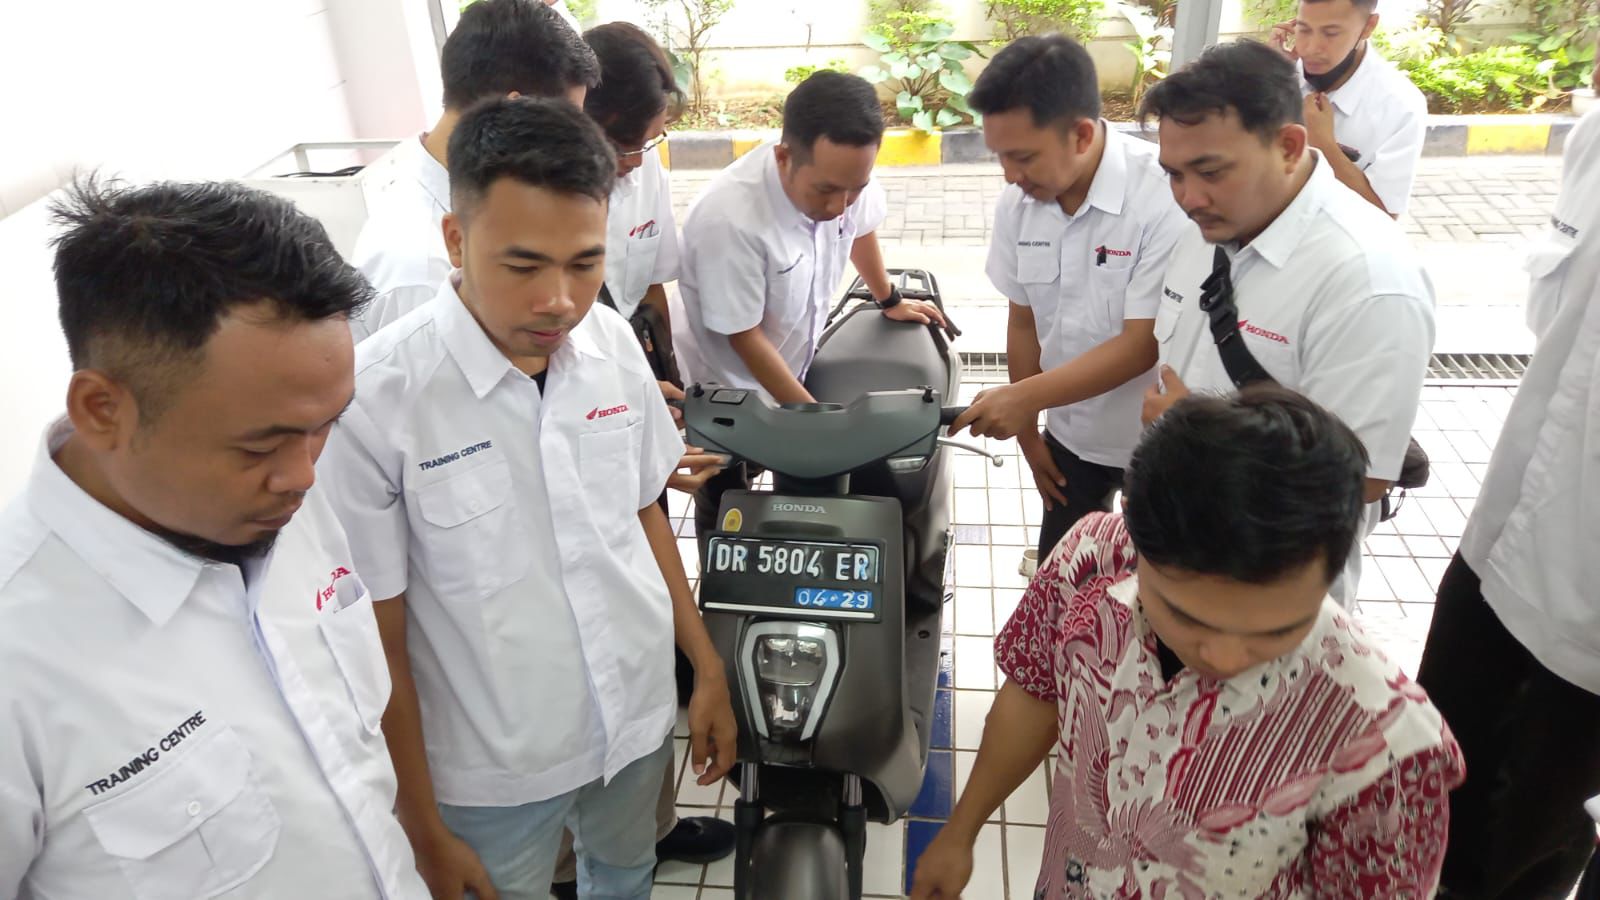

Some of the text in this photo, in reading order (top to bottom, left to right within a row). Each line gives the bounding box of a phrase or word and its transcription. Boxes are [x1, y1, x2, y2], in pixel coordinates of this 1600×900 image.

[1246, 324, 1289, 344] HONDA
[418, 440, 493, 471] TRAINING CENTRE
[773, 503, 827, 514] HONDA
[716, 543, 868, 580] DR 5804 ER
[85, 710, 207, 797] TRAINING CENTRE
